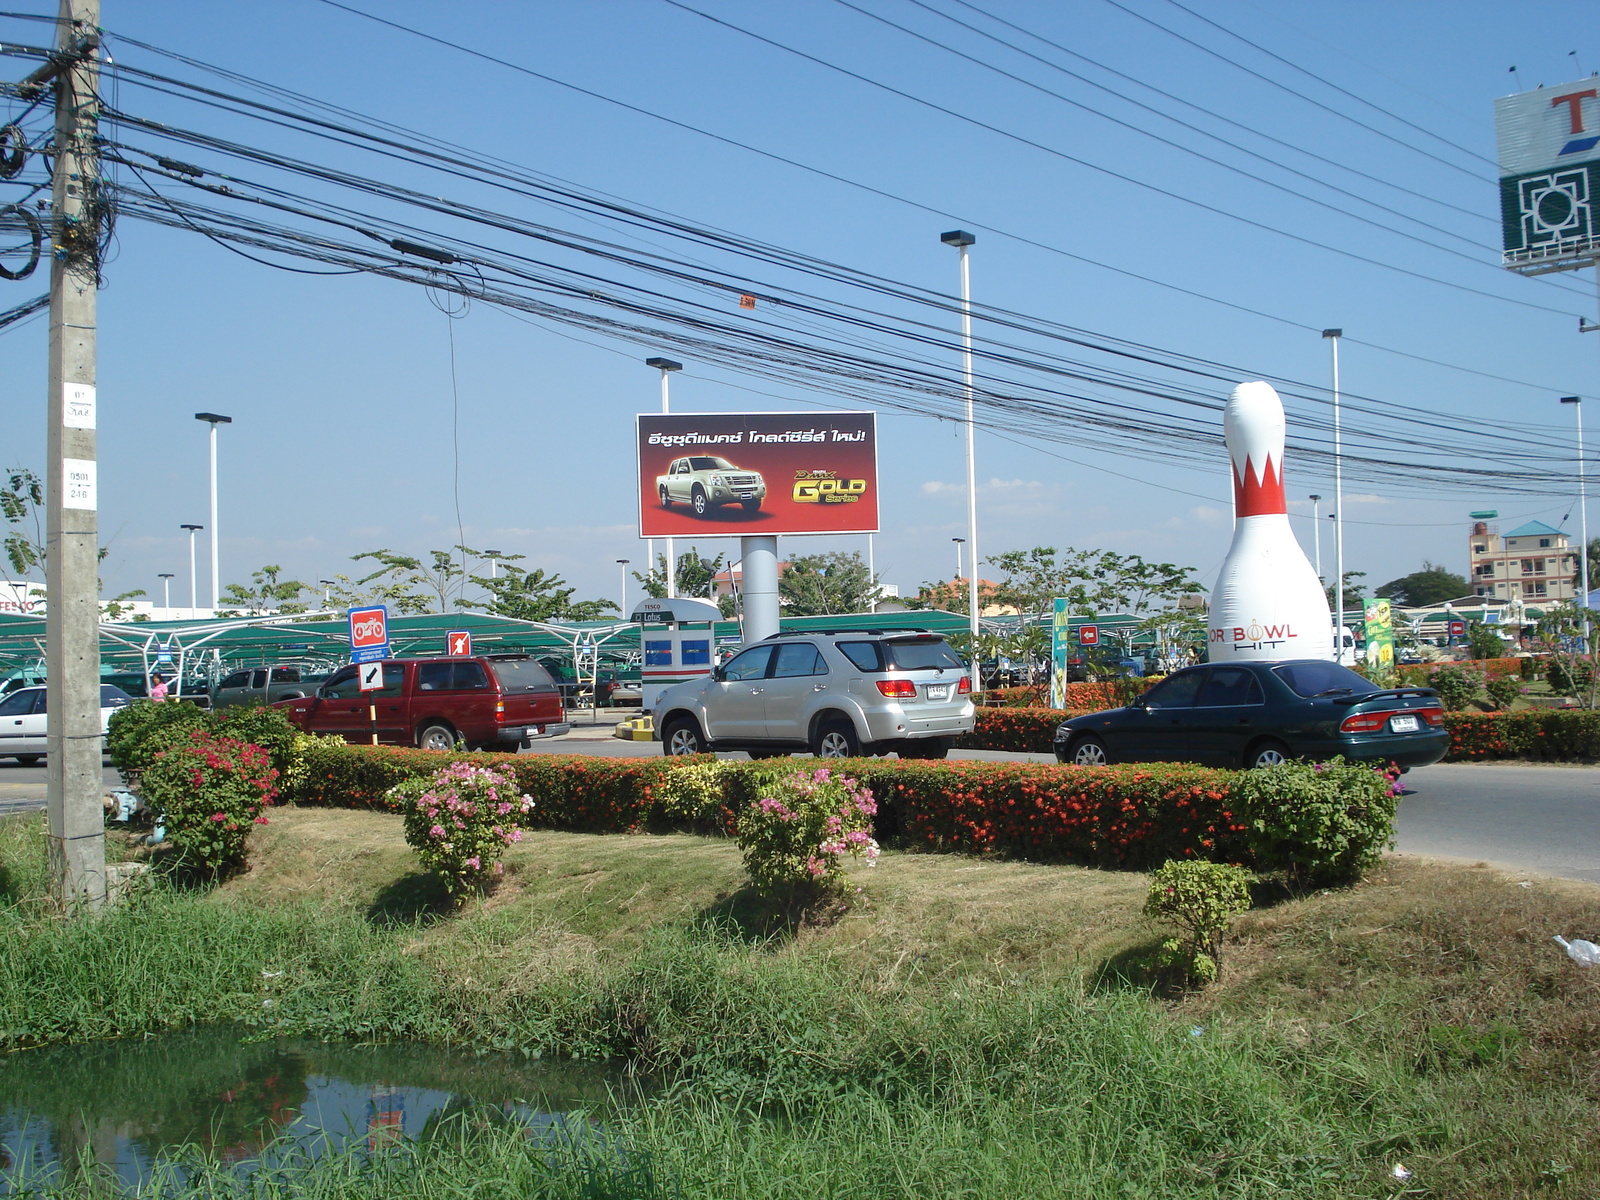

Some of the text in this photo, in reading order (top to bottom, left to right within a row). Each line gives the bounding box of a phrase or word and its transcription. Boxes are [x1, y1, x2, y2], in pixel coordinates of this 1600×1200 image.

[831, 430, 866, 442] ใหม่!
[793, 480, 866, 502] GOLD
[825, 493, 859, 502] Series
[643, 612, 661, 621] Lotus
[1232, 621, 1298, 642] BOWL
[1233, 640, 1286, 651] HIT
